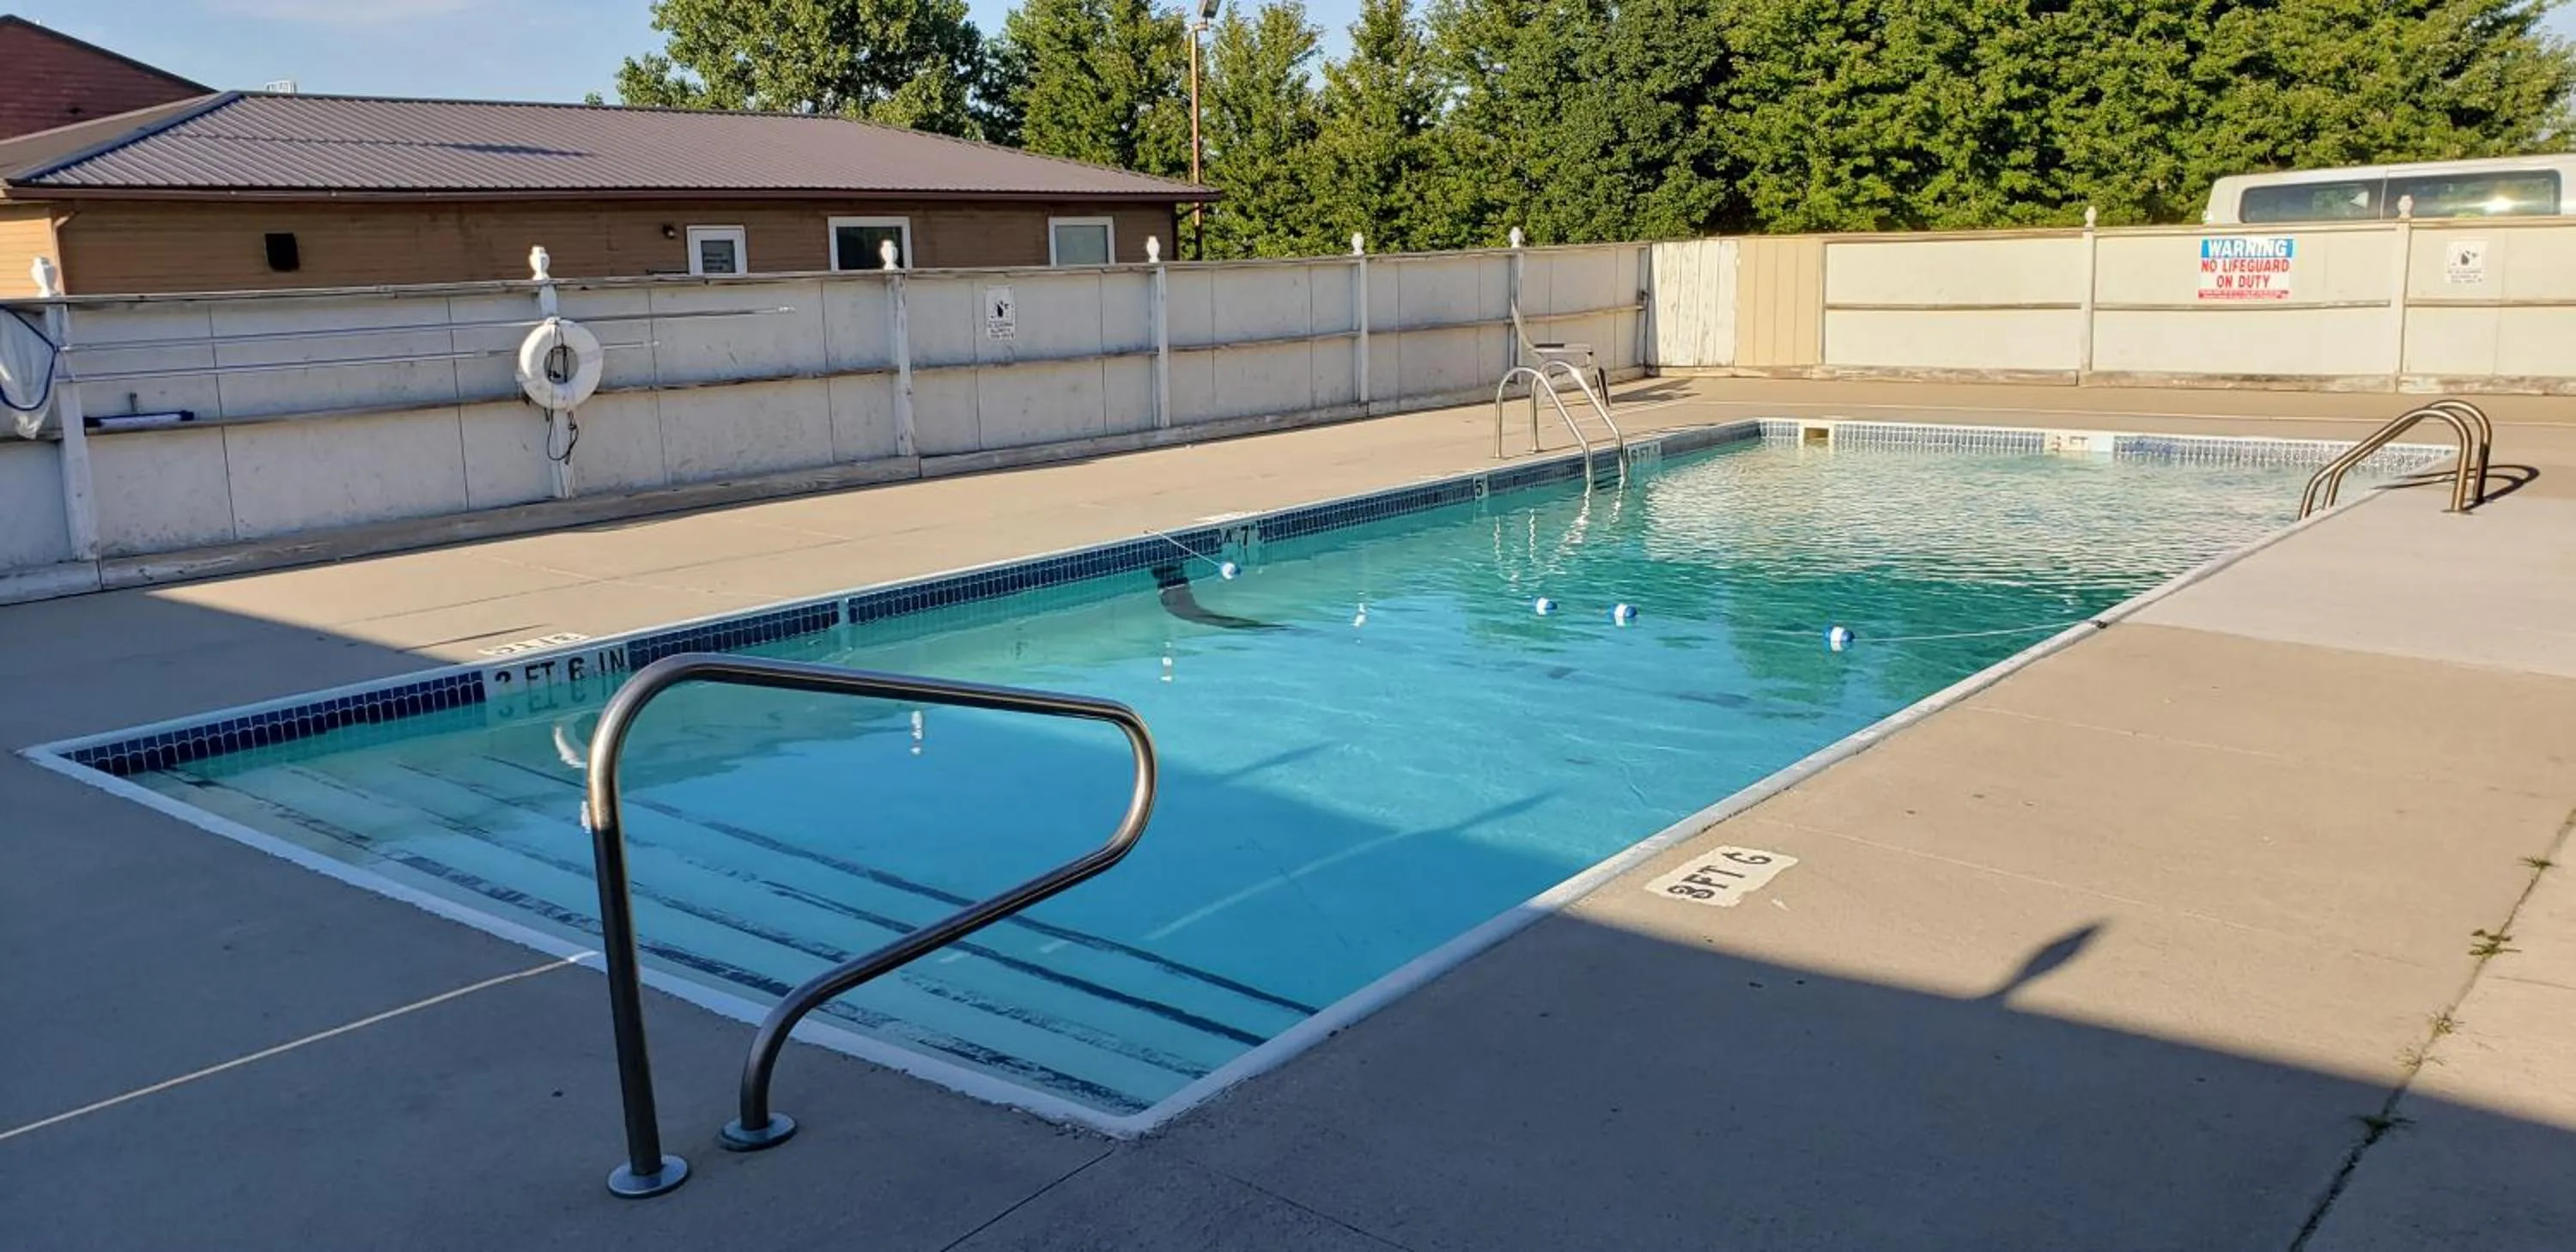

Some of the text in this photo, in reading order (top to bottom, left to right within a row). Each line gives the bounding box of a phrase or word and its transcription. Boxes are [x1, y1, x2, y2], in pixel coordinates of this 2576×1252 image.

[2208, 239, 2287, 257] WARNING
[2201, 258, 2290, 272] NO LIFEGUARD
[2216, 274, 2270, 288] ON DUTY
[1721, 851, 1773, 866] 6
